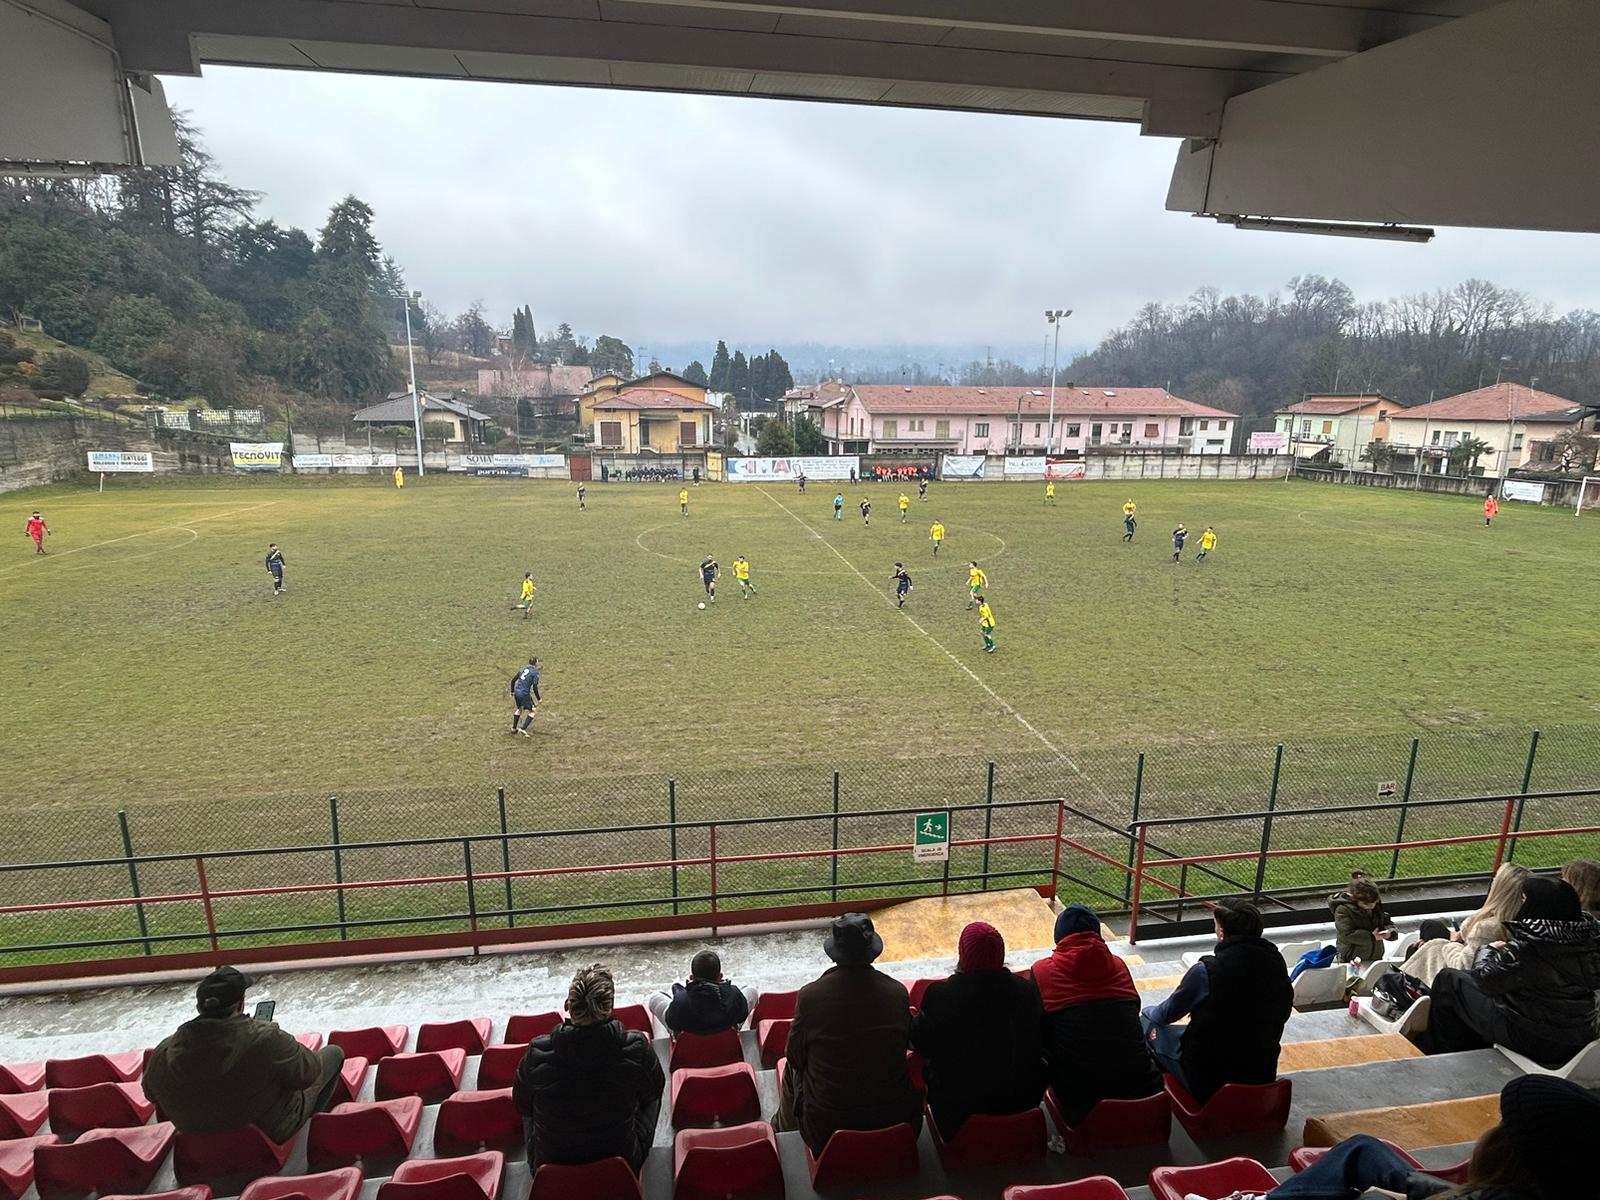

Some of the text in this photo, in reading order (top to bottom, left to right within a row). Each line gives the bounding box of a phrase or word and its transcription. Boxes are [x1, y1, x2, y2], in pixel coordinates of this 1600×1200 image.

[232, 451, 280, 460] TECNOVIT
[520, 668, 529, 680] 2
[1380, 783, 1395, 791] BAR
